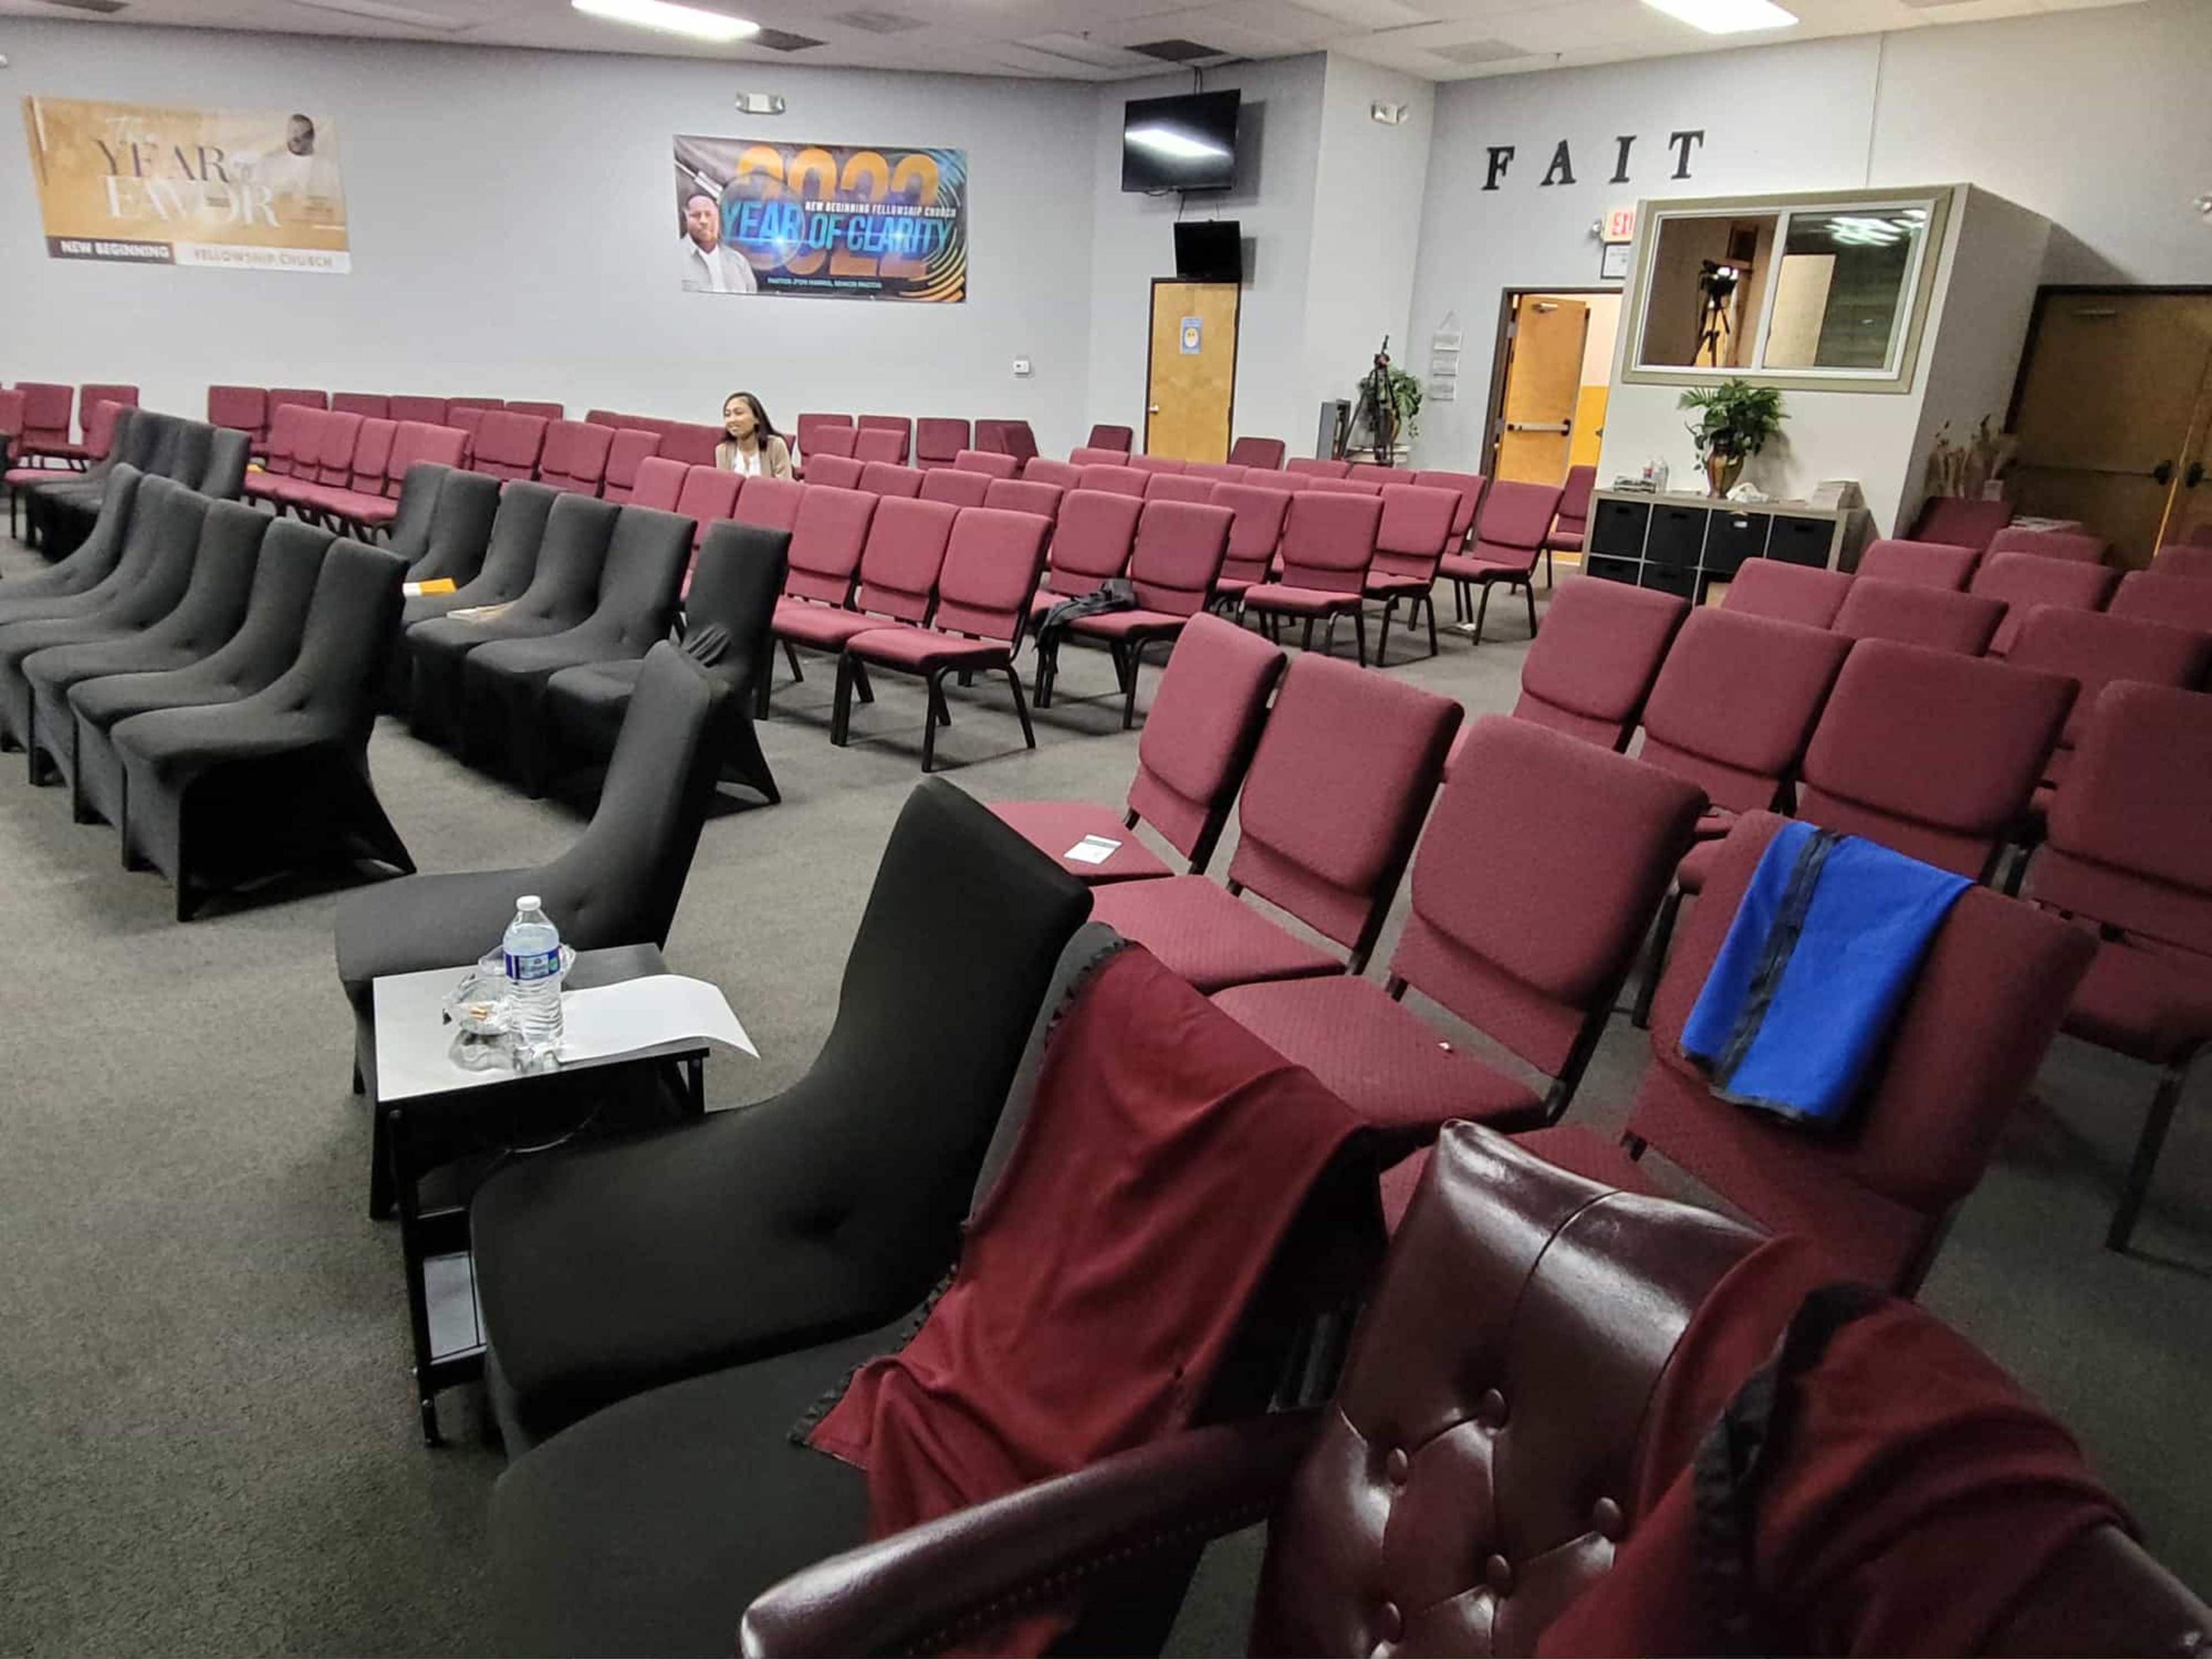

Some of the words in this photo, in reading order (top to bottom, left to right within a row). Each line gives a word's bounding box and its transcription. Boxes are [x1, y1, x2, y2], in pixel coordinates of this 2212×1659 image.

[1482, 130, 1705, 191] FAIT
[721, 200, 801, 242] YEAR
[808, 212, 842, 250] OF
[846, 214, 956, 253] CLARITY
[805, 201, 826, 211] NEW
[825, 202, 869, 213] BEGINNING
[872, 204, 922, 216] FELLOWSHIP
[924, 207, 956, 217] CHURCH
[60, 240, 92, 255] NEW
[94, 242, 170, 258] BEGINNING
[280, 252, 332, 267] CHURCH
